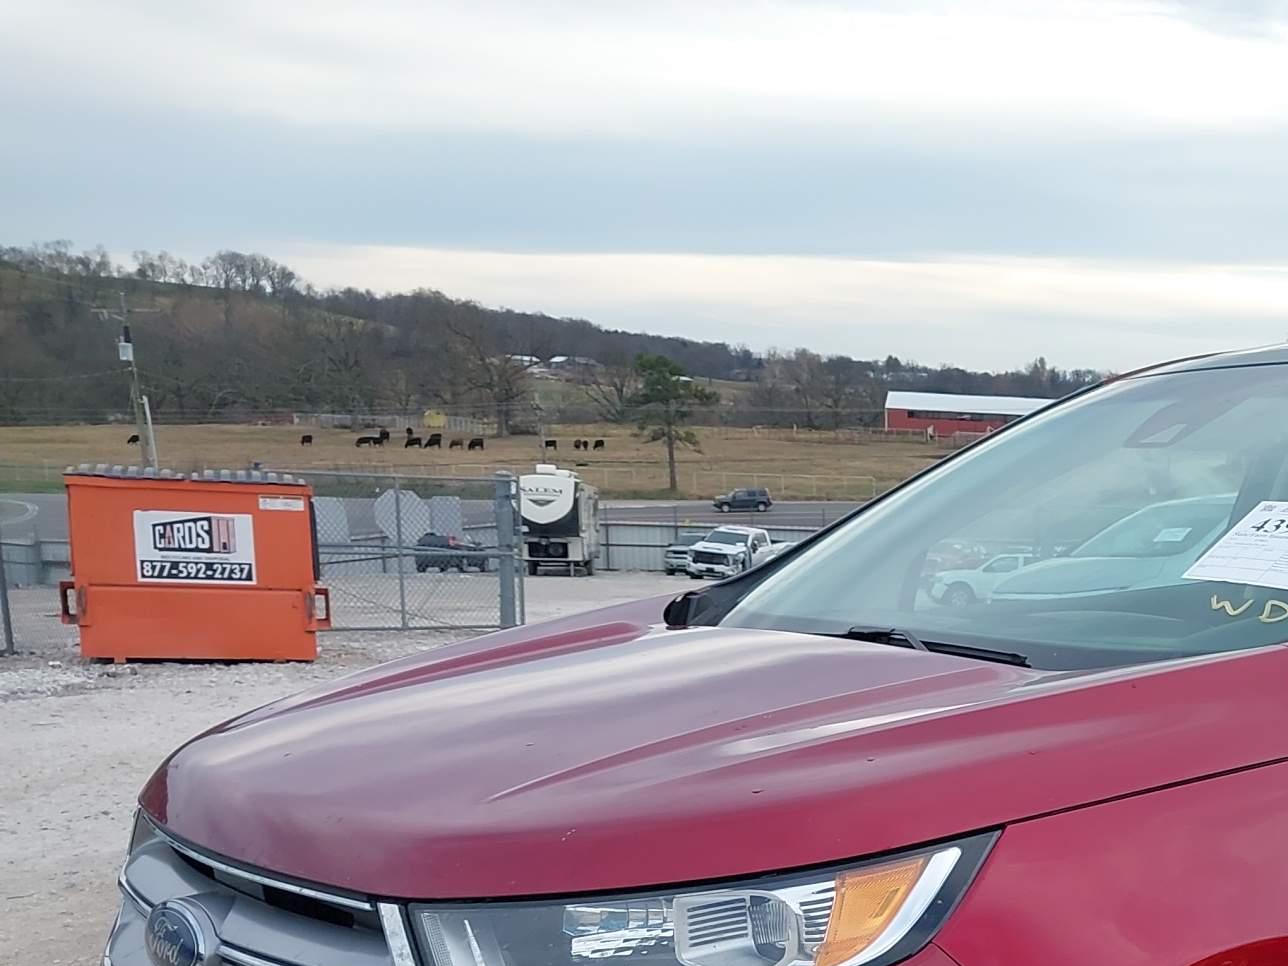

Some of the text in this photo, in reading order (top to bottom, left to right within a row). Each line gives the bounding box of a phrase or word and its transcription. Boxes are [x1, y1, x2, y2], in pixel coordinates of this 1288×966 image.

[154, 520, 210, 549] CARDS
[142, 561, 250, 579] 877-592-2737
[149, 917, 184, 966] Ford
